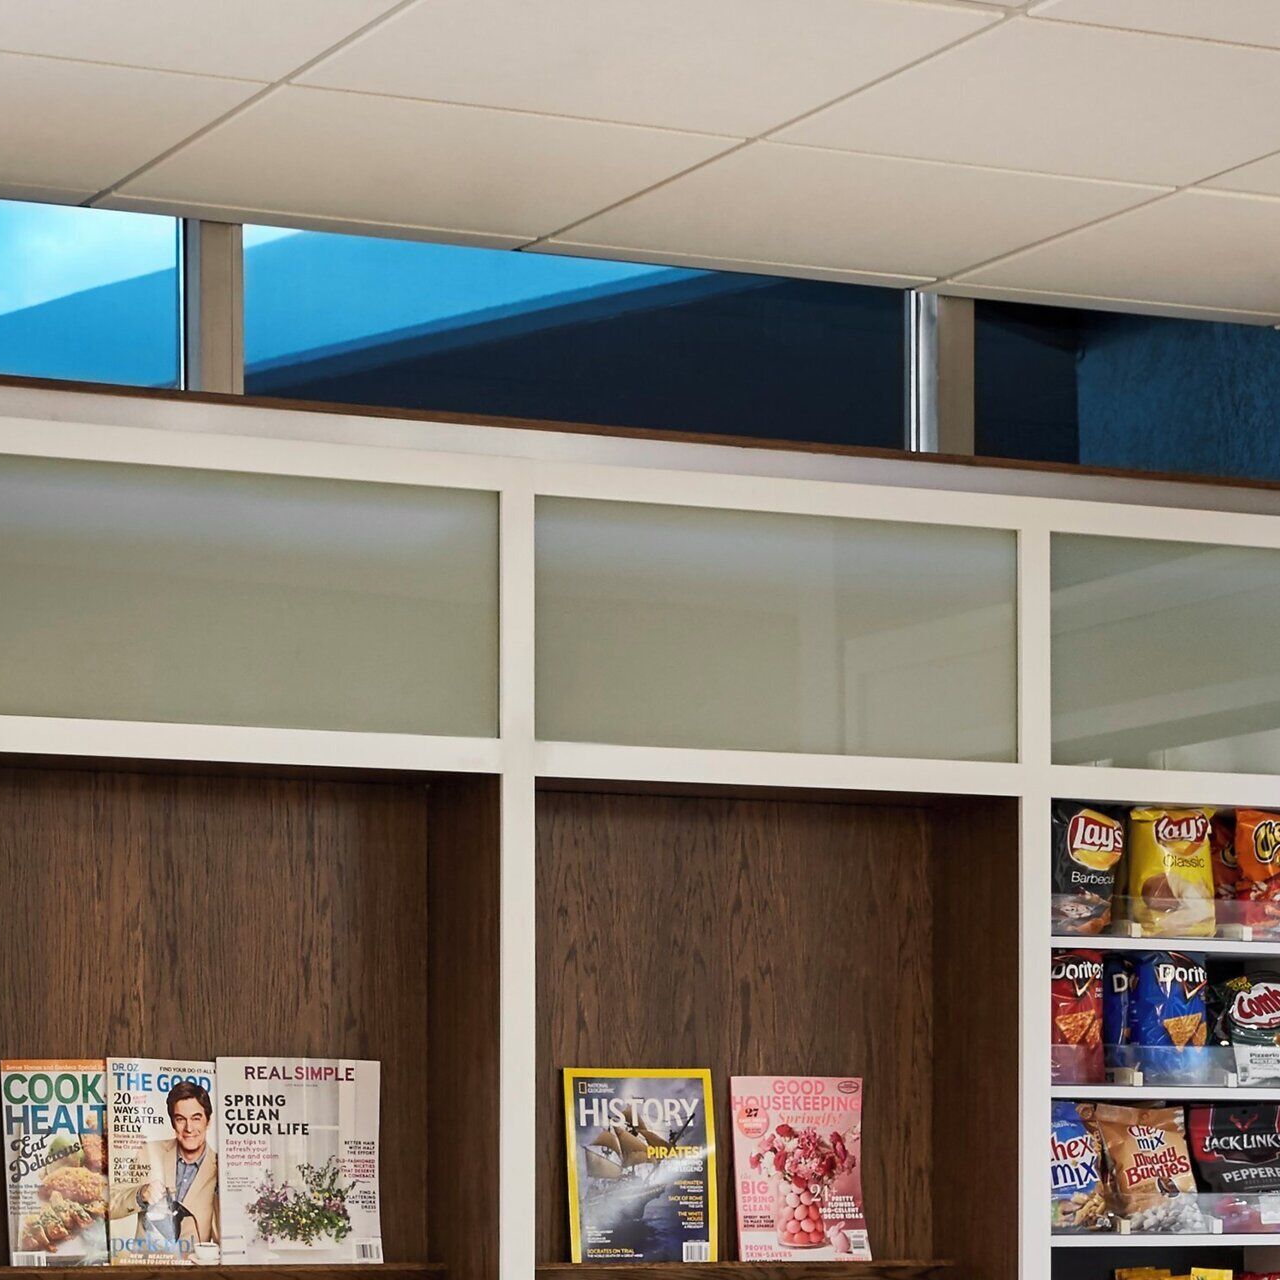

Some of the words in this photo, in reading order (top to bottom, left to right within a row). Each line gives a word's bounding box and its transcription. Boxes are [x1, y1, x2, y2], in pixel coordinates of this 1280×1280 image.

[1163, 854, 1205, 868] Classic
[1071, 871, 1115, 885] Barbecu
[1159, 963, 1206, 983] Dorit
[112, 1072, 152, 1091] THE
[772, 1080, 825, 1094] GOOD
[113, 1092, 131, 1105] 20
[224, 1095, 286, 1106] SPRING
[732, 1096, 860, 1111] HOUSEKEEPING
[113, 1106, 139, 1114] WAYS
[143, 1107, 154, 1115] TO
[225, 1109, 279, 1121] CLEAN
[578, 1098, 699, 1127] HISTORY
[745, 1108, 759, 1117] 27
[5, 1105, 107, 1134] HEALT
[113, 1115, 121, 1123] A
[122, 1116, 164, 1124] FLATTER
[113, 1124, 142, 1133] BELLY
[226, 1123, 272, 1135] YOUR
[277, 1123, 309, 1135] LIFE
[10, 1130, 51, 1159] Eat
[1137, 1131, 1165, 1151] mix
[1202, 1136, 1243, 1152] JACK
[646, 1146, 703, 1159] PIRATES!
[1051, 1137, 1094, 1162] hex
[1133, 1147, 1177, 1168] Muddy
[1052, 1156, 1098, 1186] mix
[1125, 1156, 1190, 1186] Buddies
[741, 1181, 769, 1195] BIG
